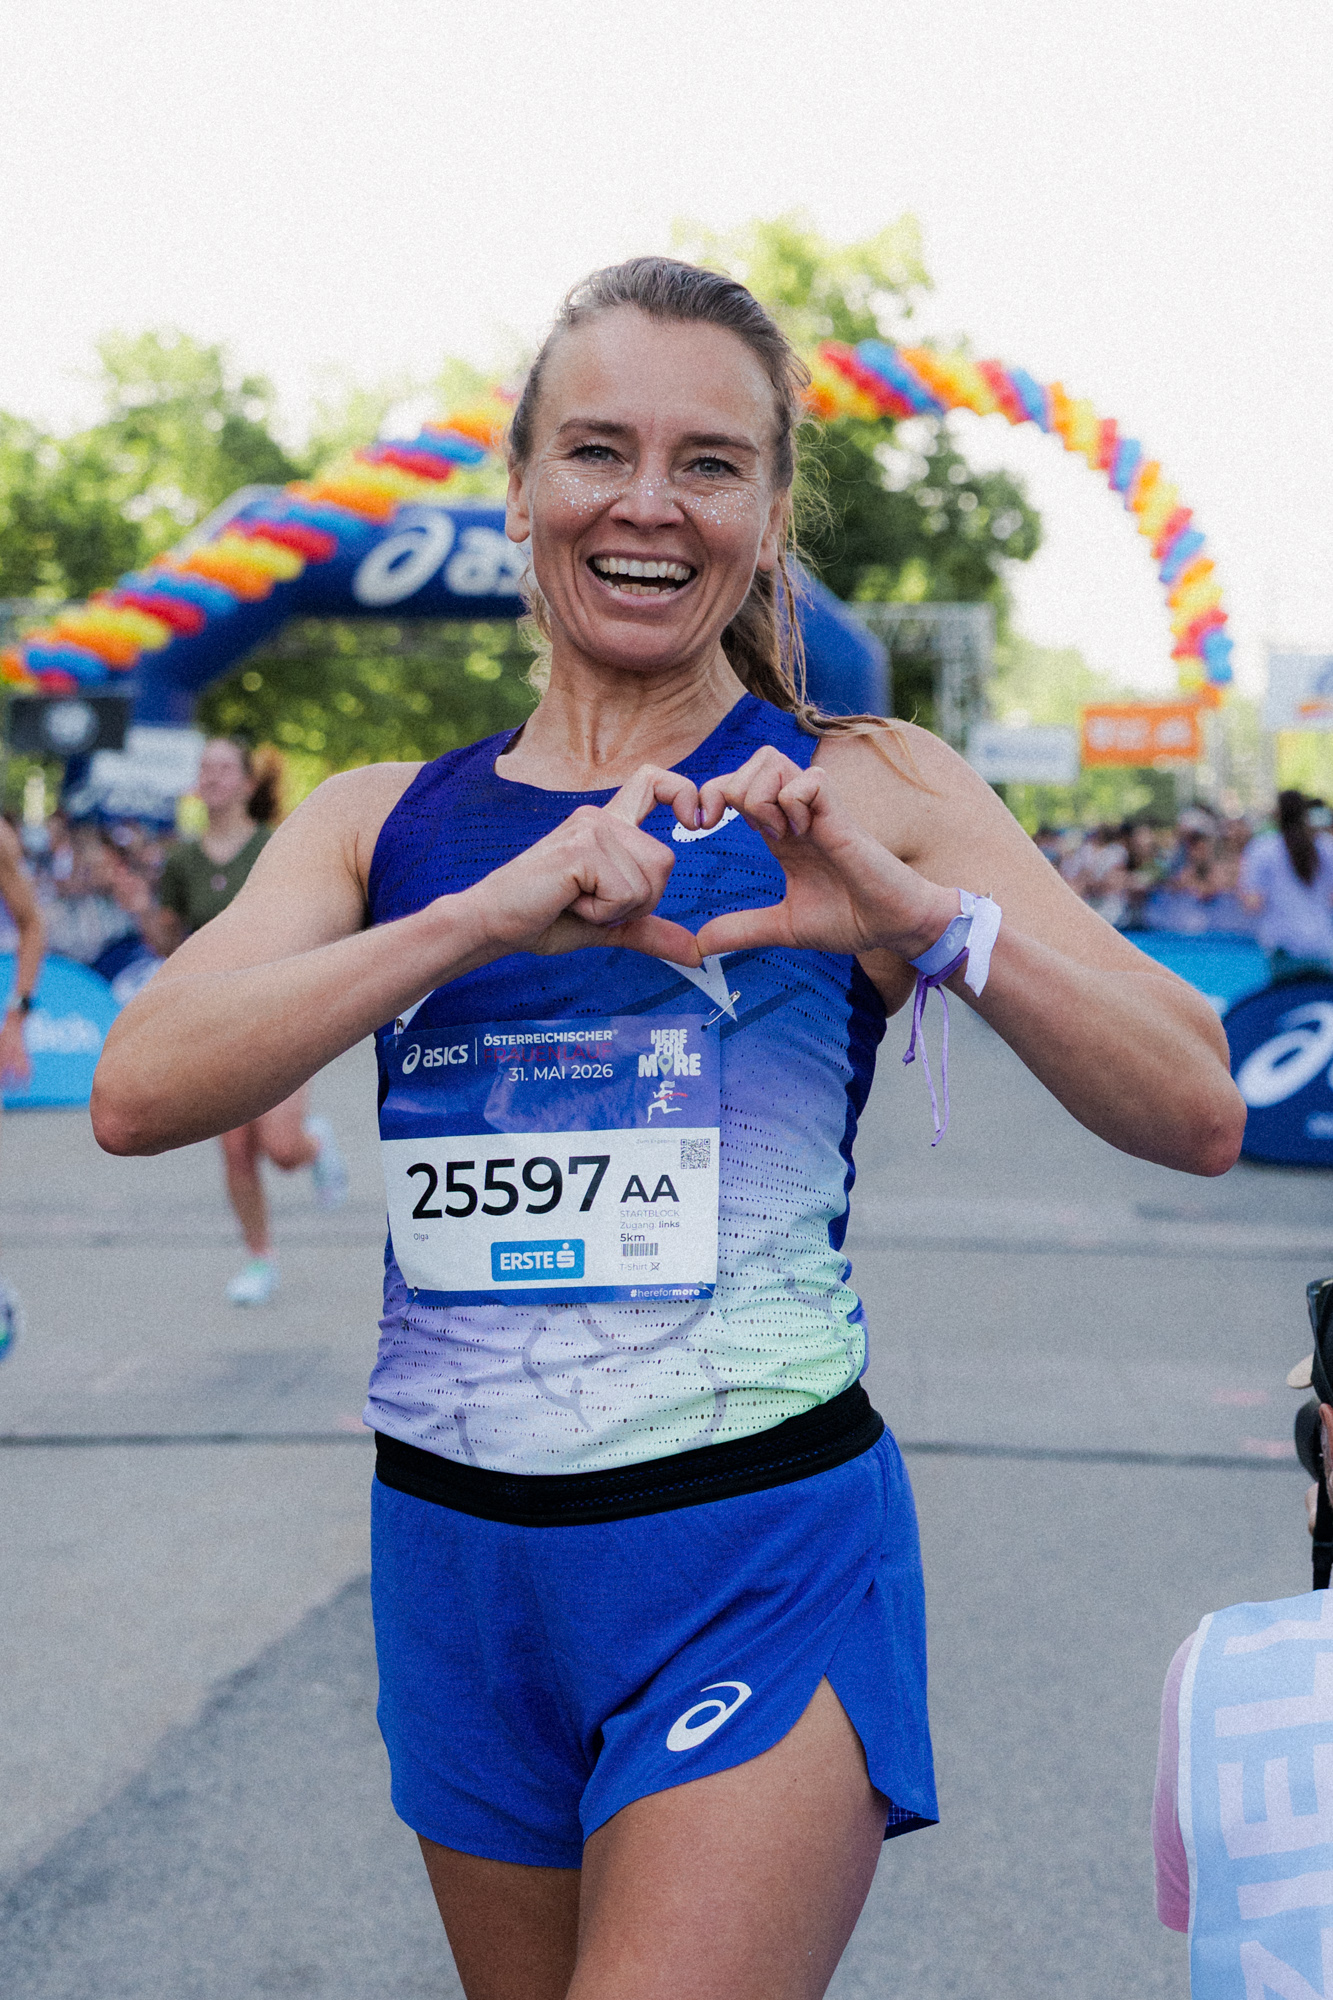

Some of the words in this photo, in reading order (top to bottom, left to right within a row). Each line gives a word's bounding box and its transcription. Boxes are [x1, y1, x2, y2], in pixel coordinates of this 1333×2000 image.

[650, 1028, 688, 1045] HERE
[484, 1041, 613, 1062] FRAUENLAUF
[654, 1040, 684, 1057] FOR
[508, 1066, 529, 1082] 31.
[534, 1065, 565, 1081] MAI
[571, 1063, 613, 1080] 2026
[406, 1154, 611, 1219] 25597
[619, 1174, 680, 1203] AA
[619, 1209, 680, 1218] STARTBLOCK
[658, 1220, 680, 1229] links
[413, 1232, 429, 1242] Olga
[619, 1232, 646, 1242] 5km
[500, 1251, 554, 1271] ERSTE
[620, 1263, 648, 1271] T-Shirt
[630, 1286, 701, 1298] #hereformore
